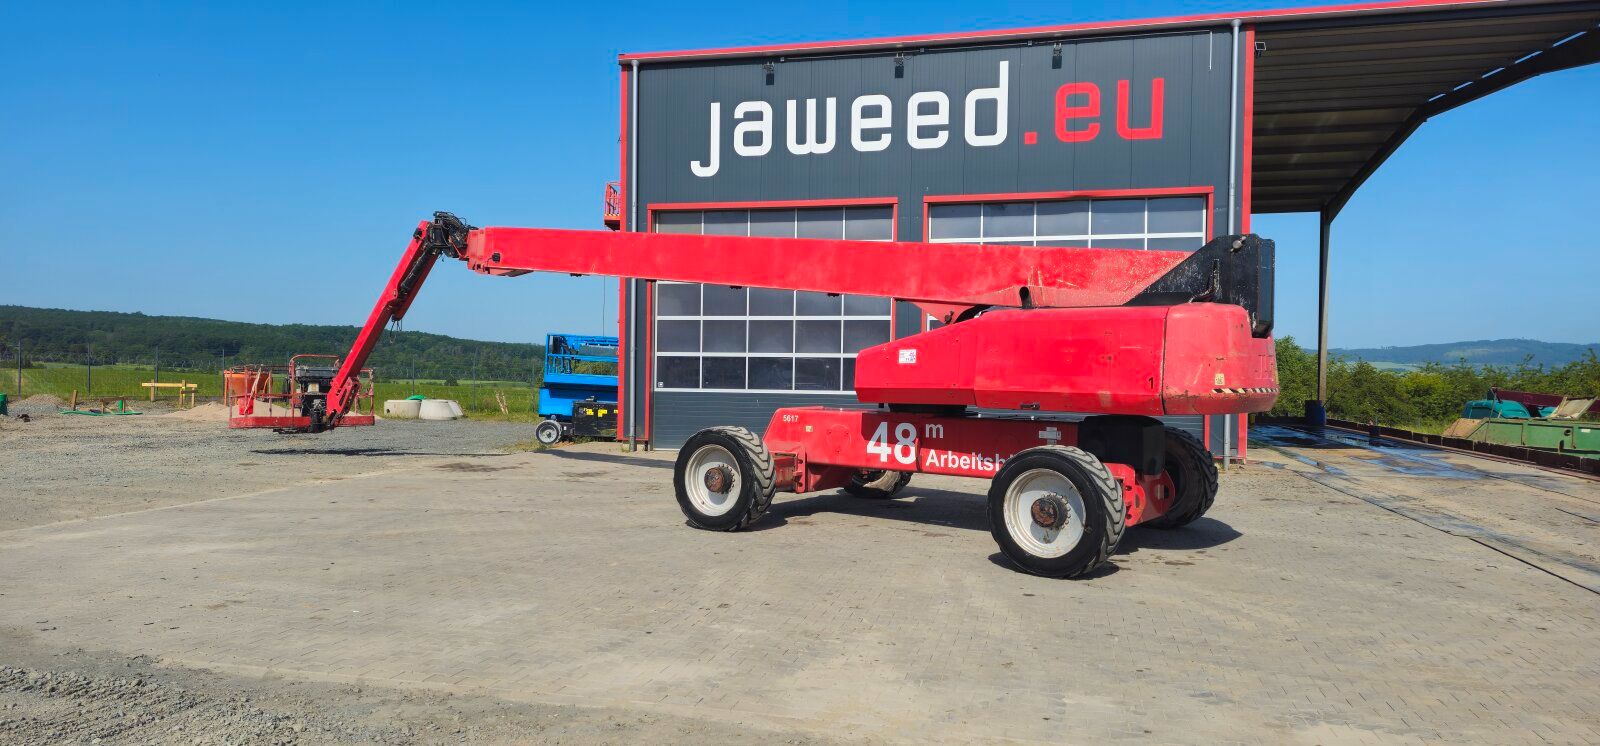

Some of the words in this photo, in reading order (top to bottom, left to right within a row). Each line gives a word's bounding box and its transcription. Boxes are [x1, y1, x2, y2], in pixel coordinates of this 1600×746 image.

[690, 60, 1165, 177] jaweed.eu
[783, 414, 799, 422] 5617
[866, 421, 917, 465] 48
[925, 423, 943, 438] m
[925, 448, 1013, 471] Arbeitsh
